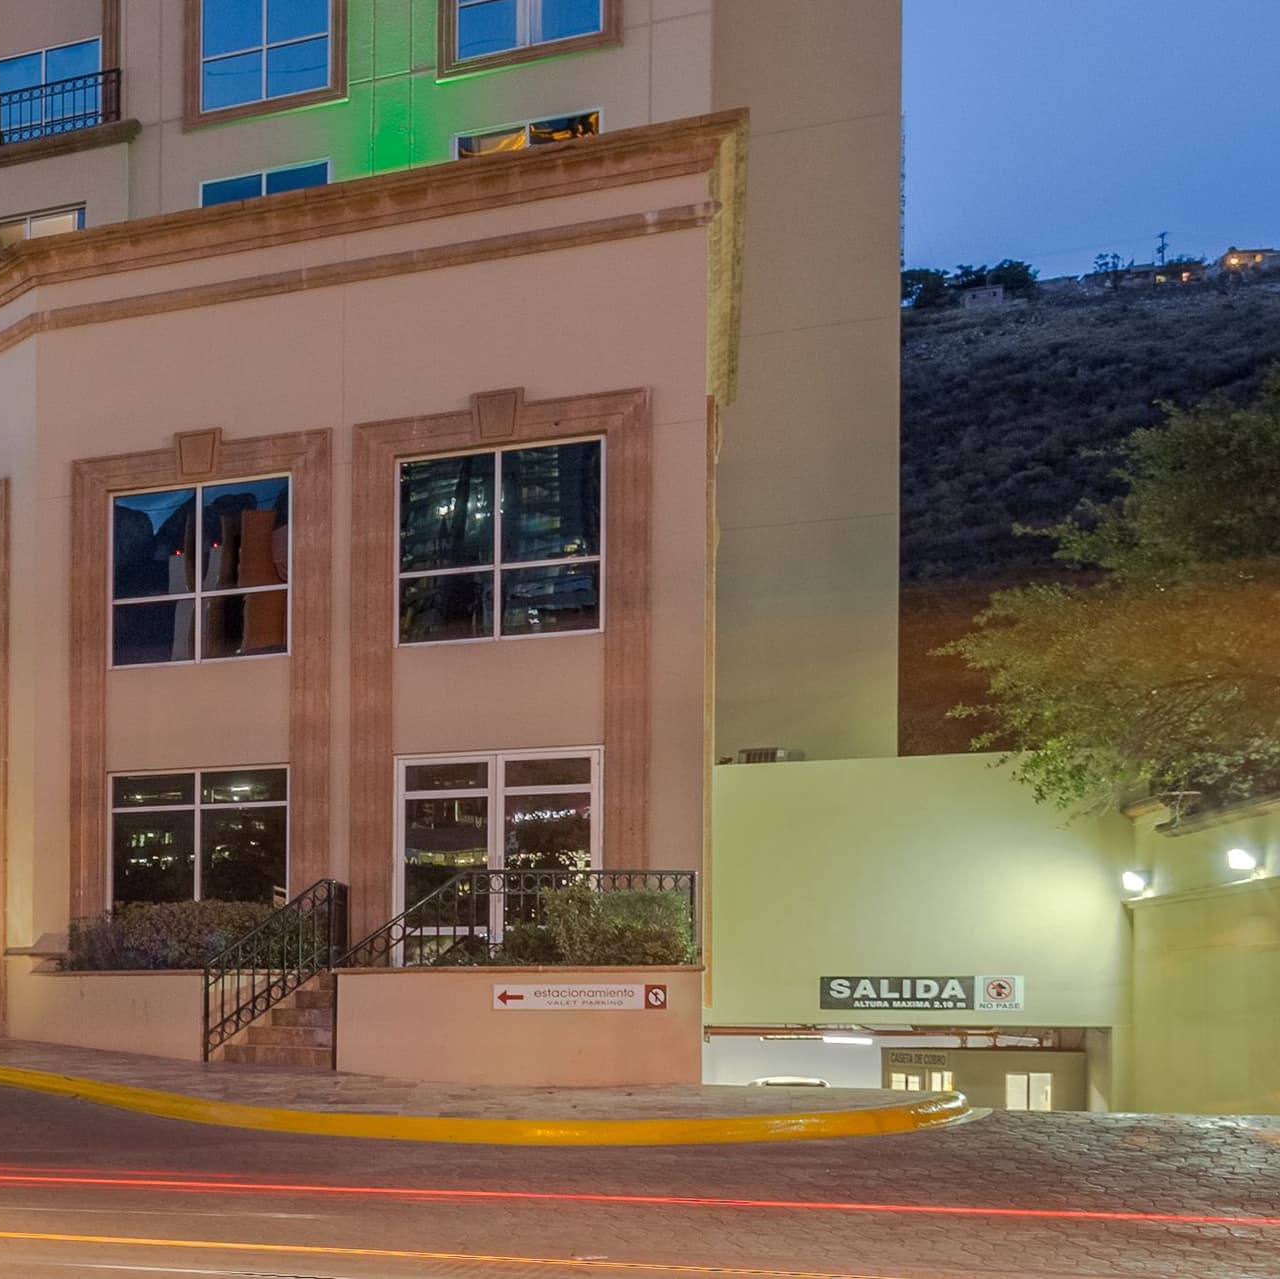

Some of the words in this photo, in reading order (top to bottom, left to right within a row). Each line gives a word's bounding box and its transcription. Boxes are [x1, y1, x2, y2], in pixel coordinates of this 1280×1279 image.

[534, 988, 635, 998] estacionamiento
[829, 979, 966, 999] SALIDA
[854, 1000, 889, 1008] ALTURA
[892, 1000, 930, 1008] MAXIMA
[933, 1000, 954, 1008] 2.10
